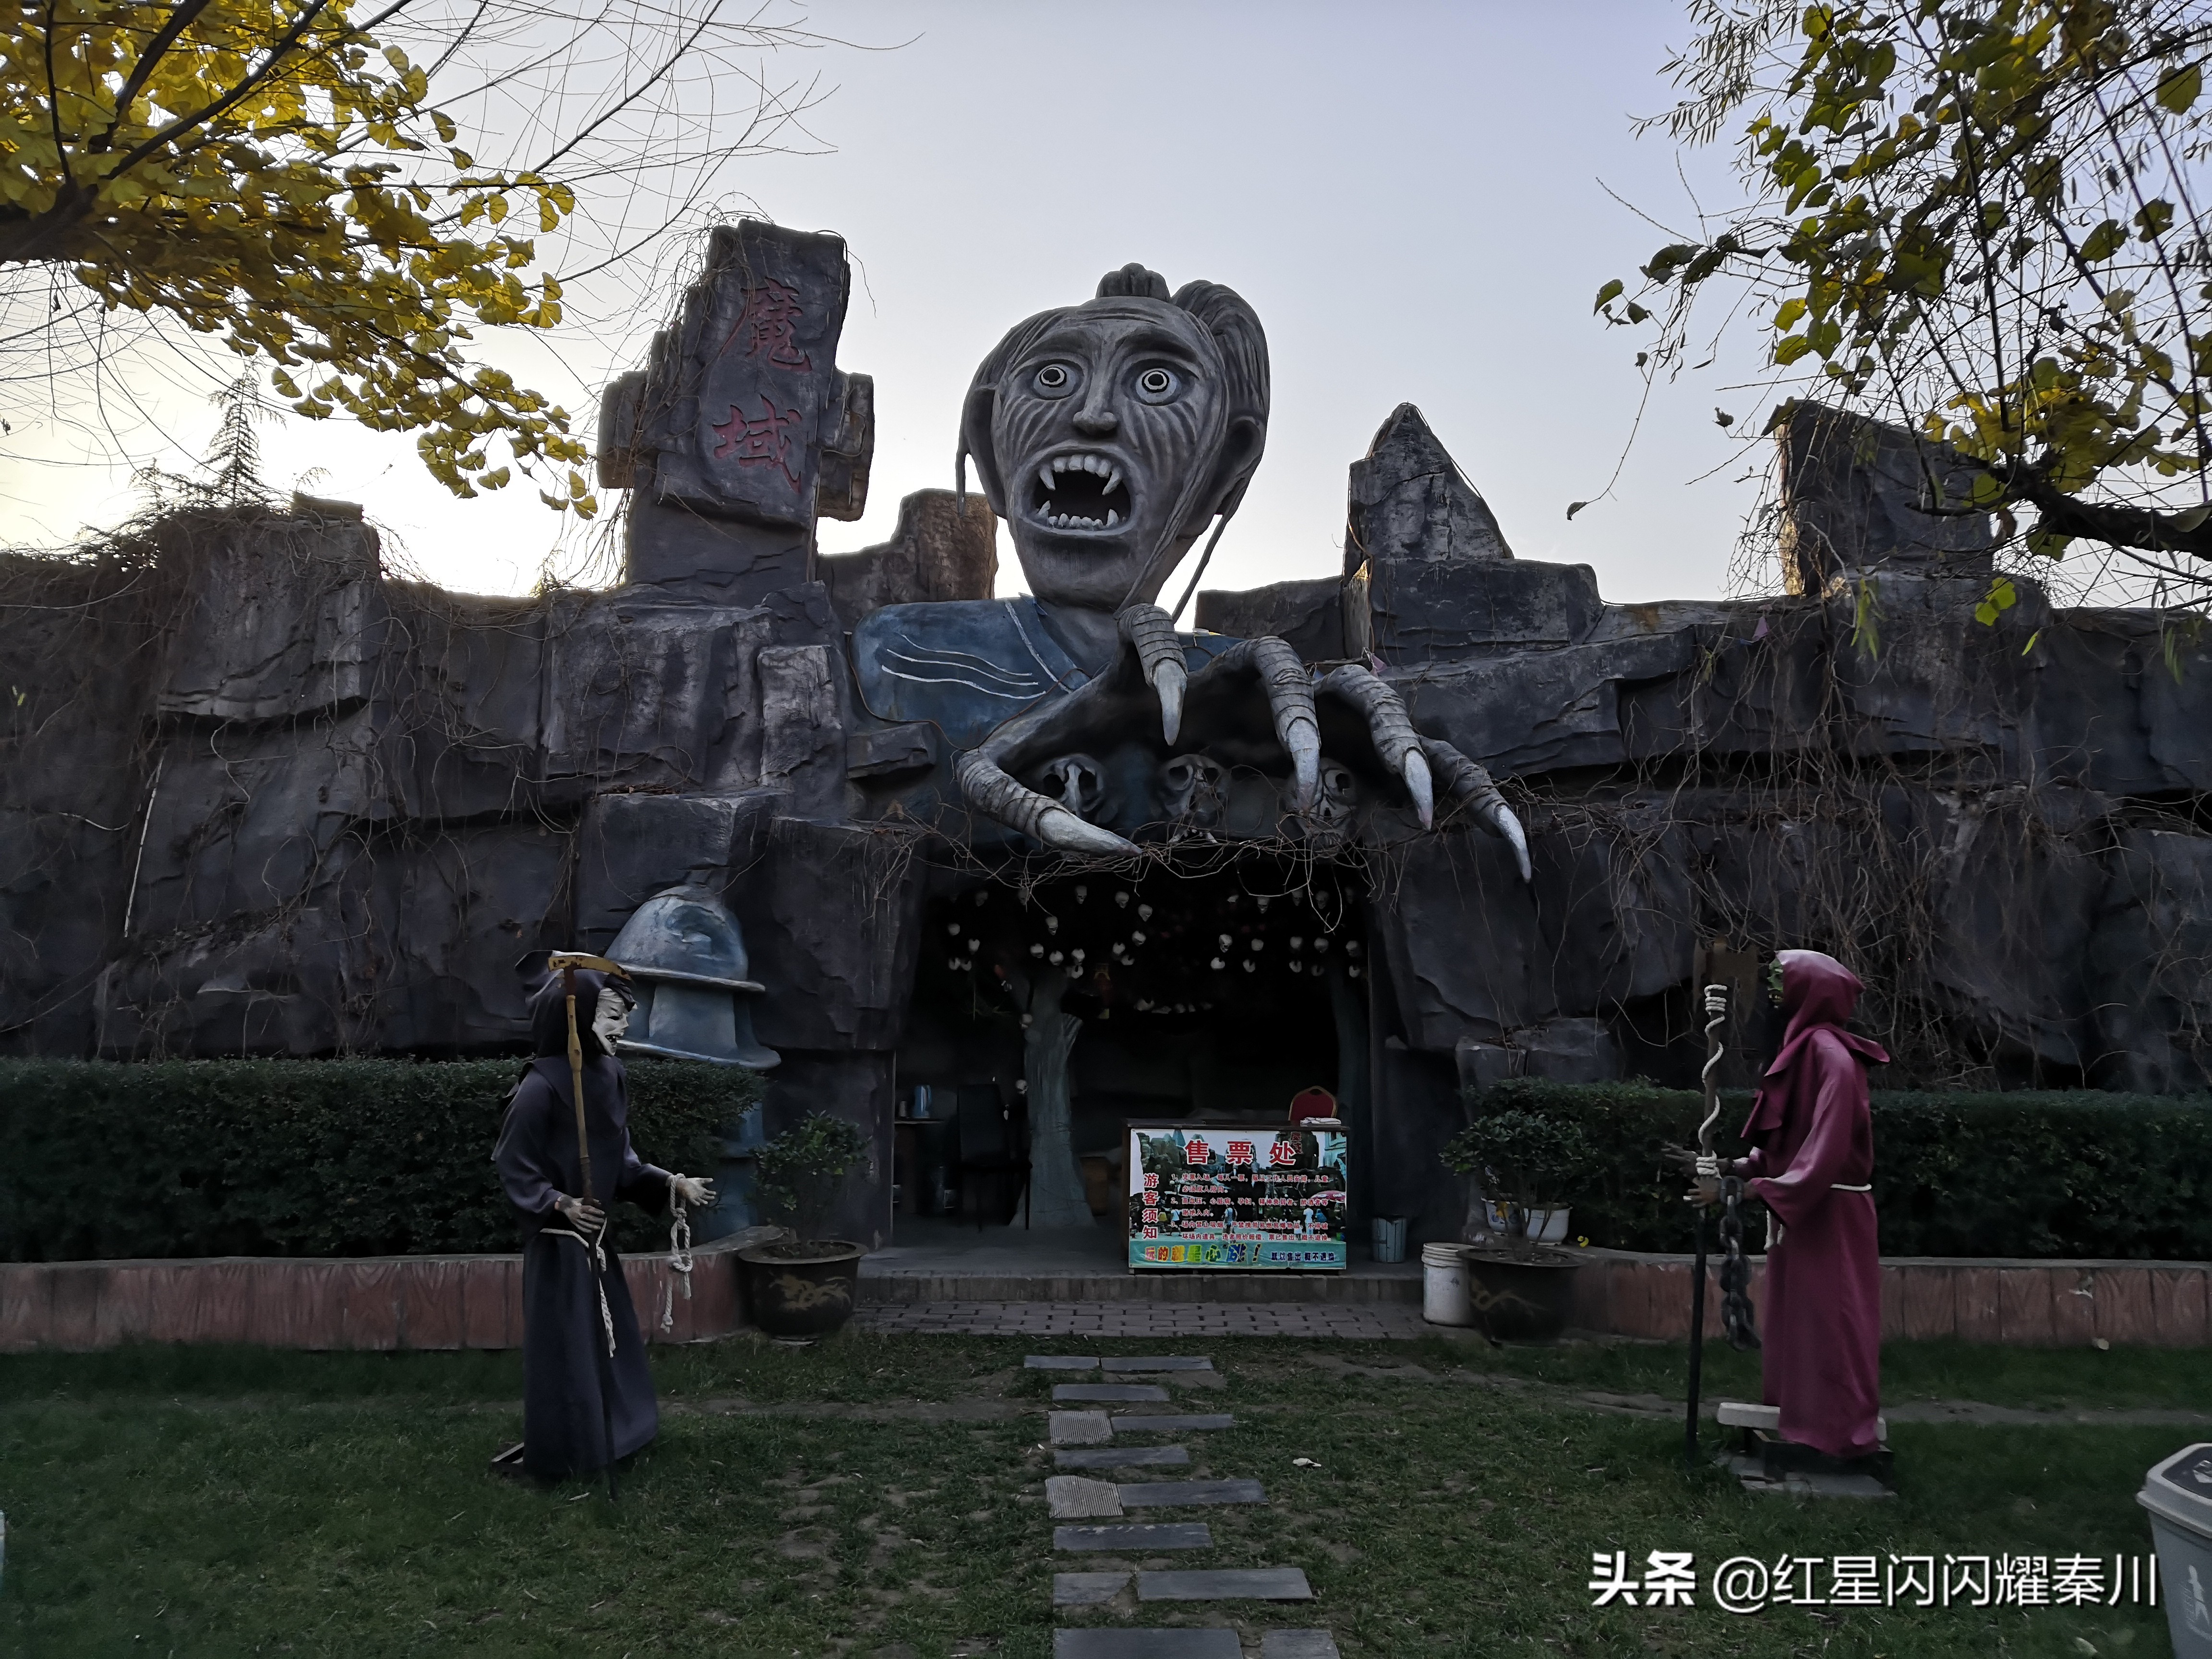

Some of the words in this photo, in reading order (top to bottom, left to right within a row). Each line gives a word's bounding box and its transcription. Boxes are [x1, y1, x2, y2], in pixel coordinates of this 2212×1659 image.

[1184, 1140, 1297, 1166] 售票处
[1142, 1173, 1159, 1239] 游客须知
